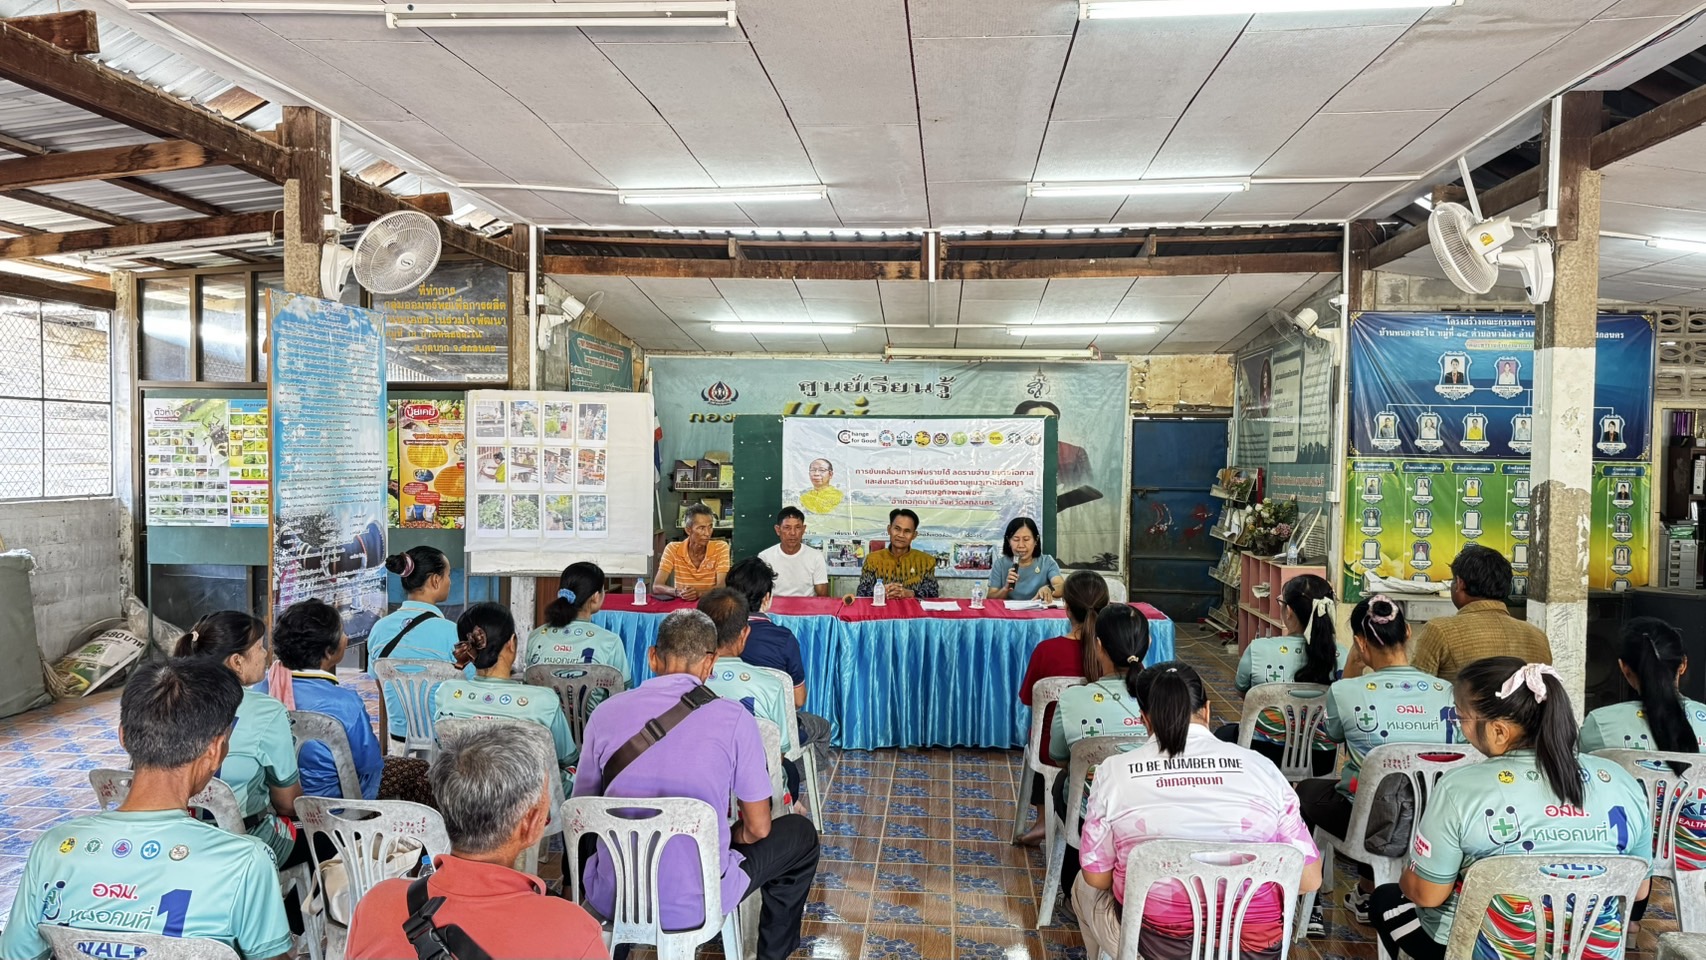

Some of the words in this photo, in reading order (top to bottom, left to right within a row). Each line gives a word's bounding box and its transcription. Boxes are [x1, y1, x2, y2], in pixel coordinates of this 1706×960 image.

[797, 373, 956, 399] ศูนย์เรียนรู้
[406, 405, 436, 418] ปุ๋ยเคมี
[1396, 704, 1427, 714] อสม.
[1386, 717, 1440, 731] หมอคนที่
[1128, 763, 1144, 774] TO
[1146, 761, 1161, 772] BE
[1163, 758, 1216, 771] NUMBER
[1219, 757, 1244, 769] ONE
[1155, 776, 1224, 789] อำเภอกุดบาก
[1544, 804, 1590, 818] อสม.
[1532, 822, 1608, 842] หมอคนที่
[92, 883, 138, 900] อสม.
[69, 907, 155, 930] หมอคนที่
[157, 889, 192, 938] 1
